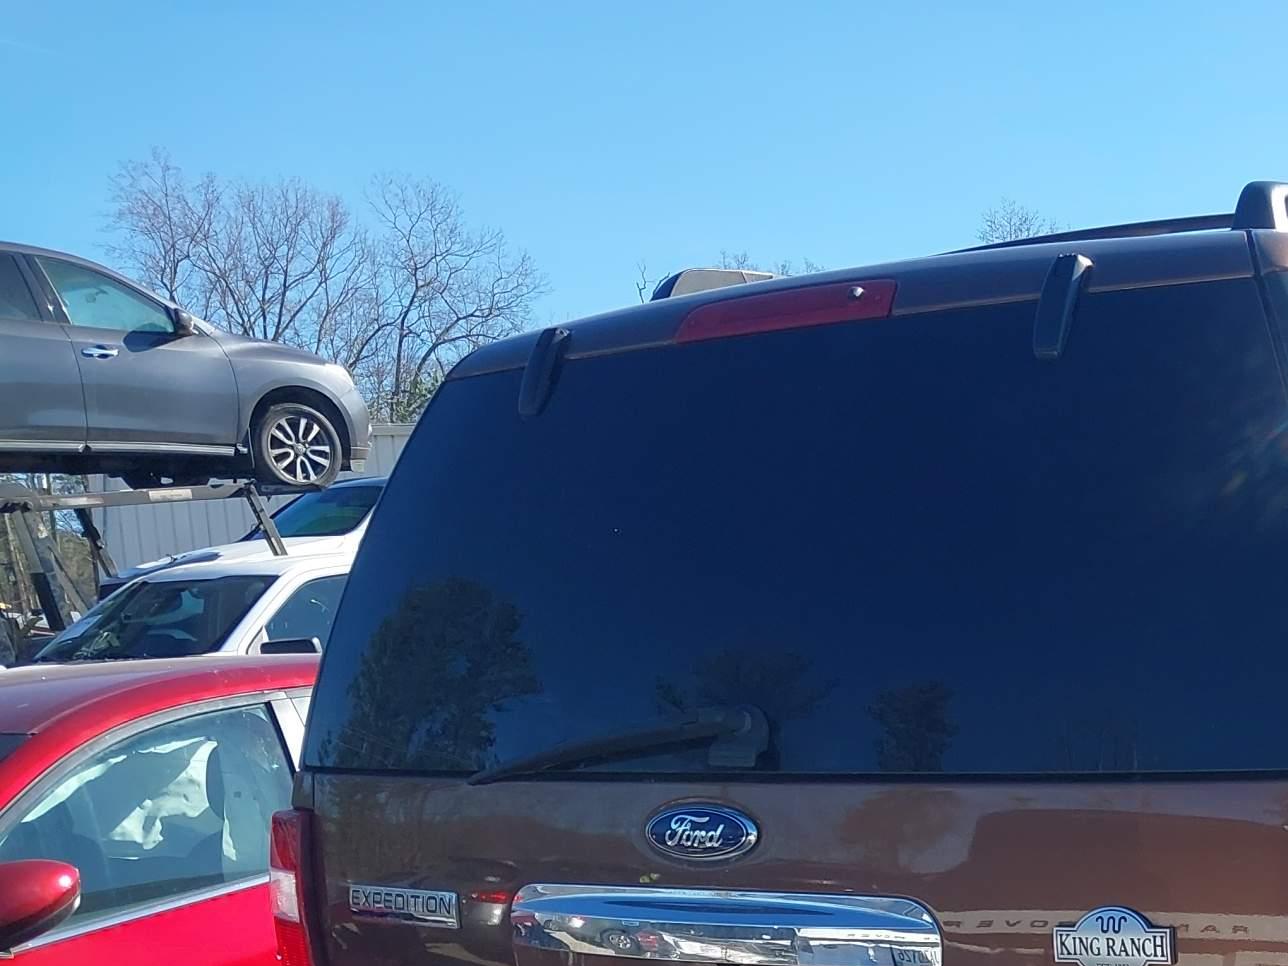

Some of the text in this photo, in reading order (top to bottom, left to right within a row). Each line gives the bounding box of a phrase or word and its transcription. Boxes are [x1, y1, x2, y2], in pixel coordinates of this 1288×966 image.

[665, 814, 725, 848] Ford
[351, 889, 451, 914] EXPEDITION
[1059, 933, 1166, 958] KING RANCH
